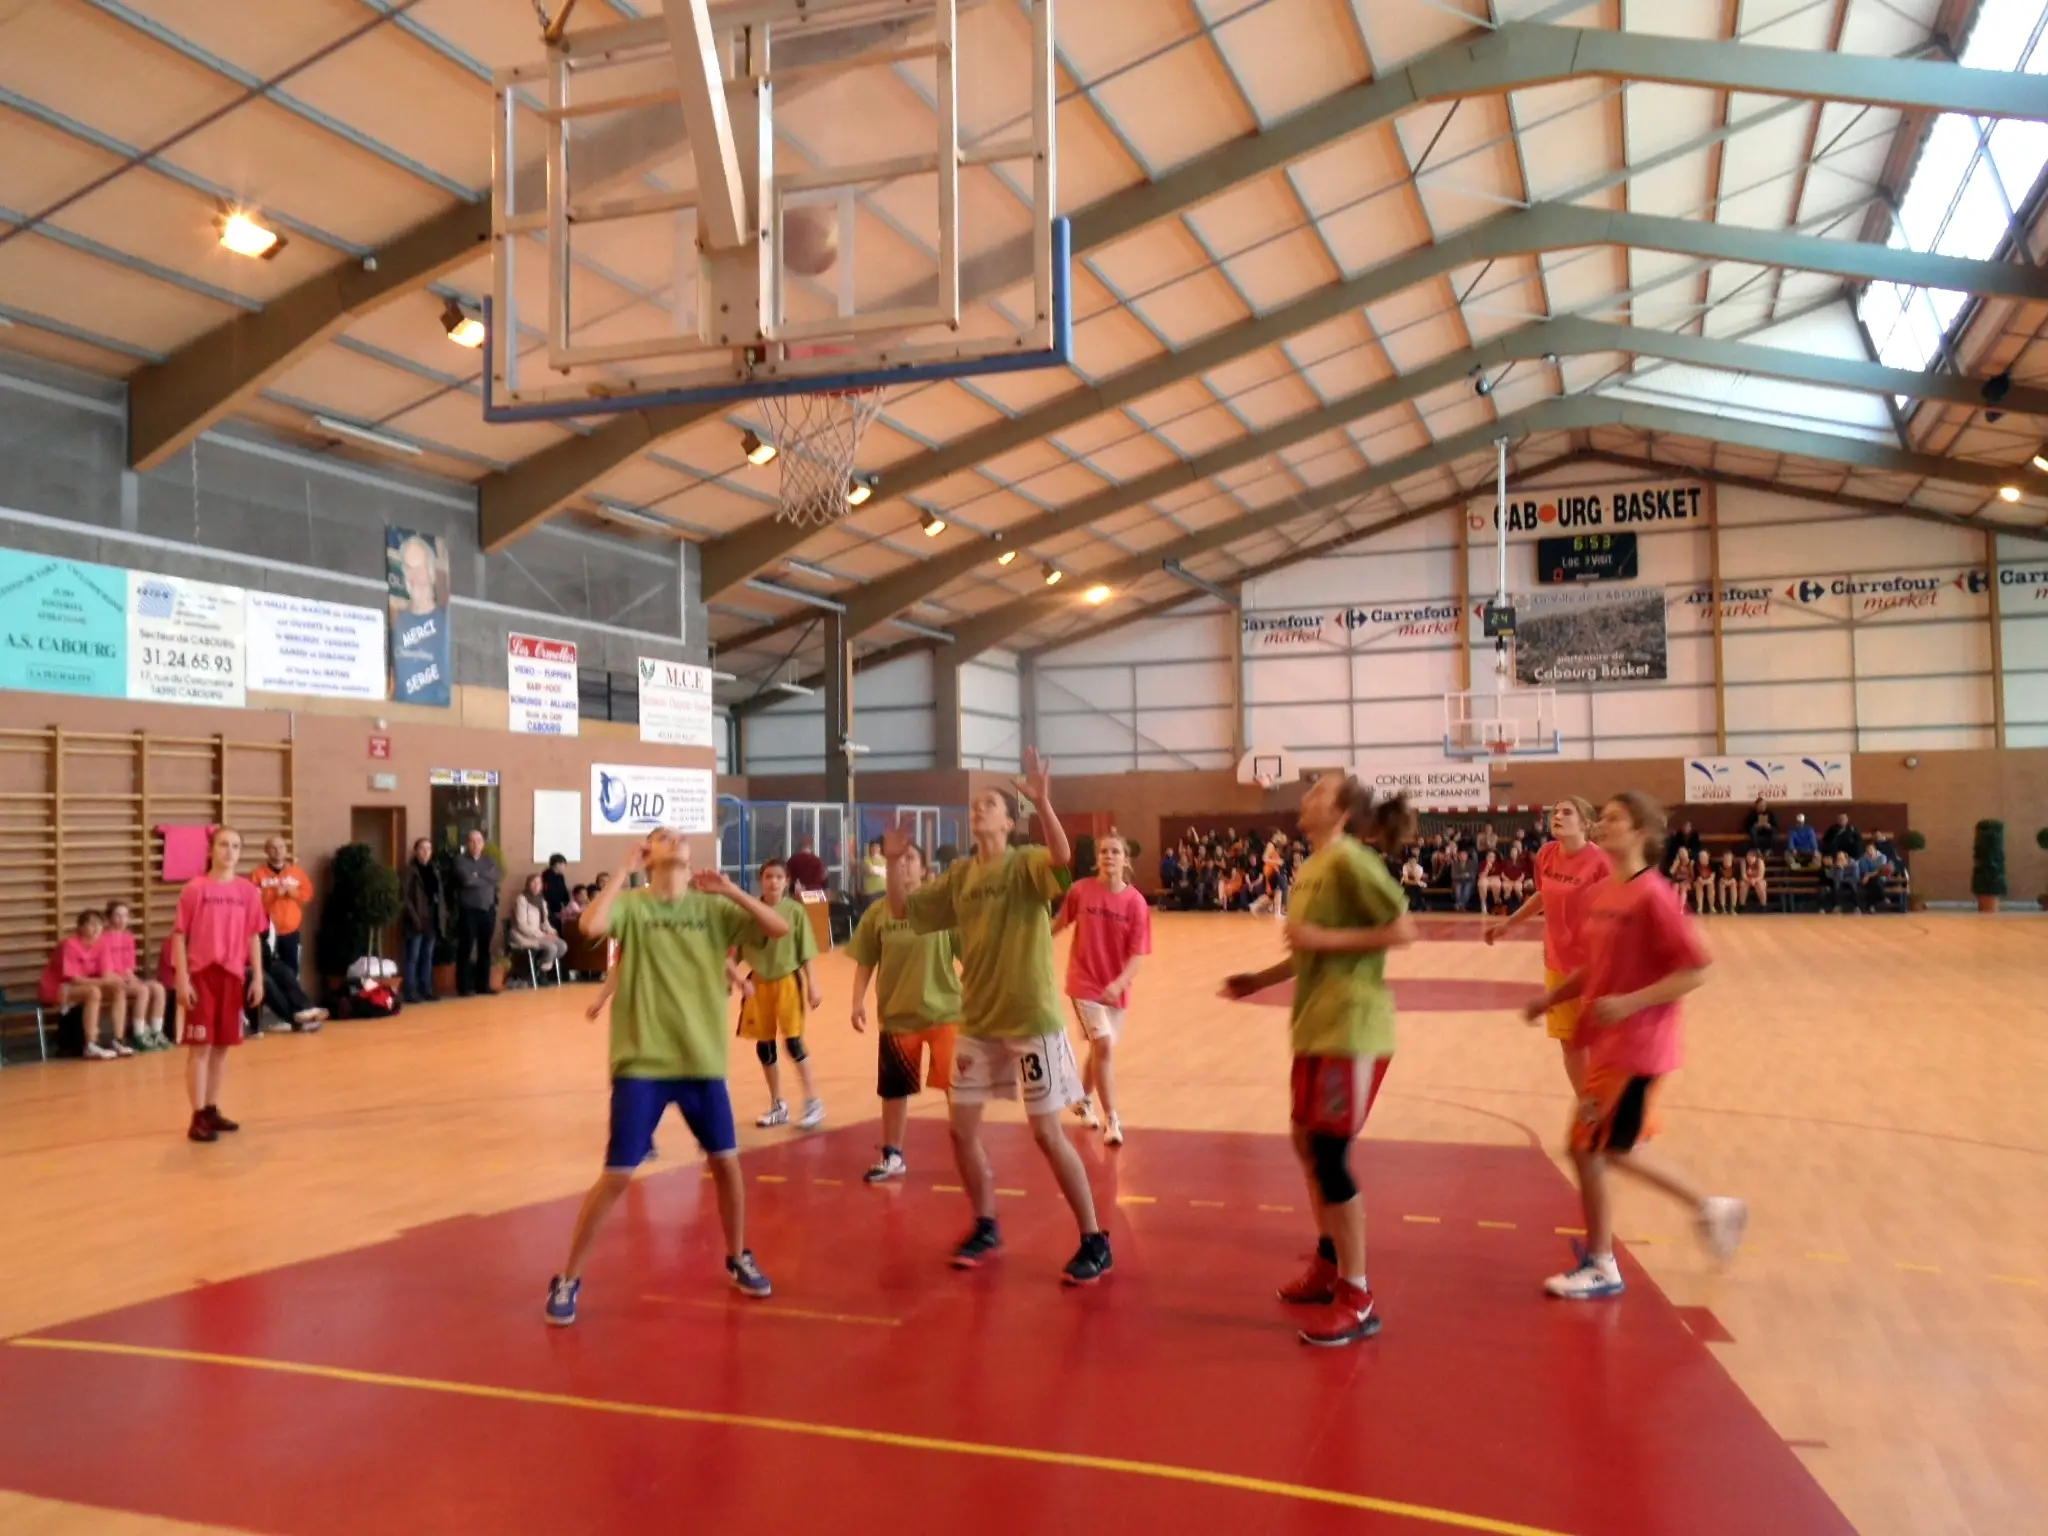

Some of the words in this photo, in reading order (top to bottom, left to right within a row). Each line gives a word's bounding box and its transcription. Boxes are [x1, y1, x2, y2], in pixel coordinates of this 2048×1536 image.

[1613, 487, 1701, 523] BASKET
[1371, 605, 1463, 623] Carrefour
[1831, 576, 1940, 596] Carrefour
[1596, 588, 1659, 601] CABOURG
[1264, 627, 1322, 644] market
[1400, 618, 1461, 637] market
[1864, 589, 1939, 611] market
[191, 634, 235, 650] CABOURG
[402, 617, 437, 648] MERCI
[38, 636, 116, 659] CABOURG
[143, 646, 232, 674] 31.24.65.93
[1534, 664, 1597, 681] Cabourg
[1601, 661, 1650, 678] Basket
[406, 663, 440, 695] SERGE
[178, 686, 223, 700] CABOURG
[527, 720, 562, 733] CABOURG
[1375, 773, 1422, 786] CONSEIL
[1427, 772, 1485, 785] REGIONAL
[1426, 788, 1481, 799] NORMANDIE
[1702, 788, 1731, 799] eaux
[1757, 787, 1787, 798] eaux
[1813, 786, 1843, 797] eaux
[630, 792, 664, 817] RLD
[1021, 1053, 1043, 1082] 13
